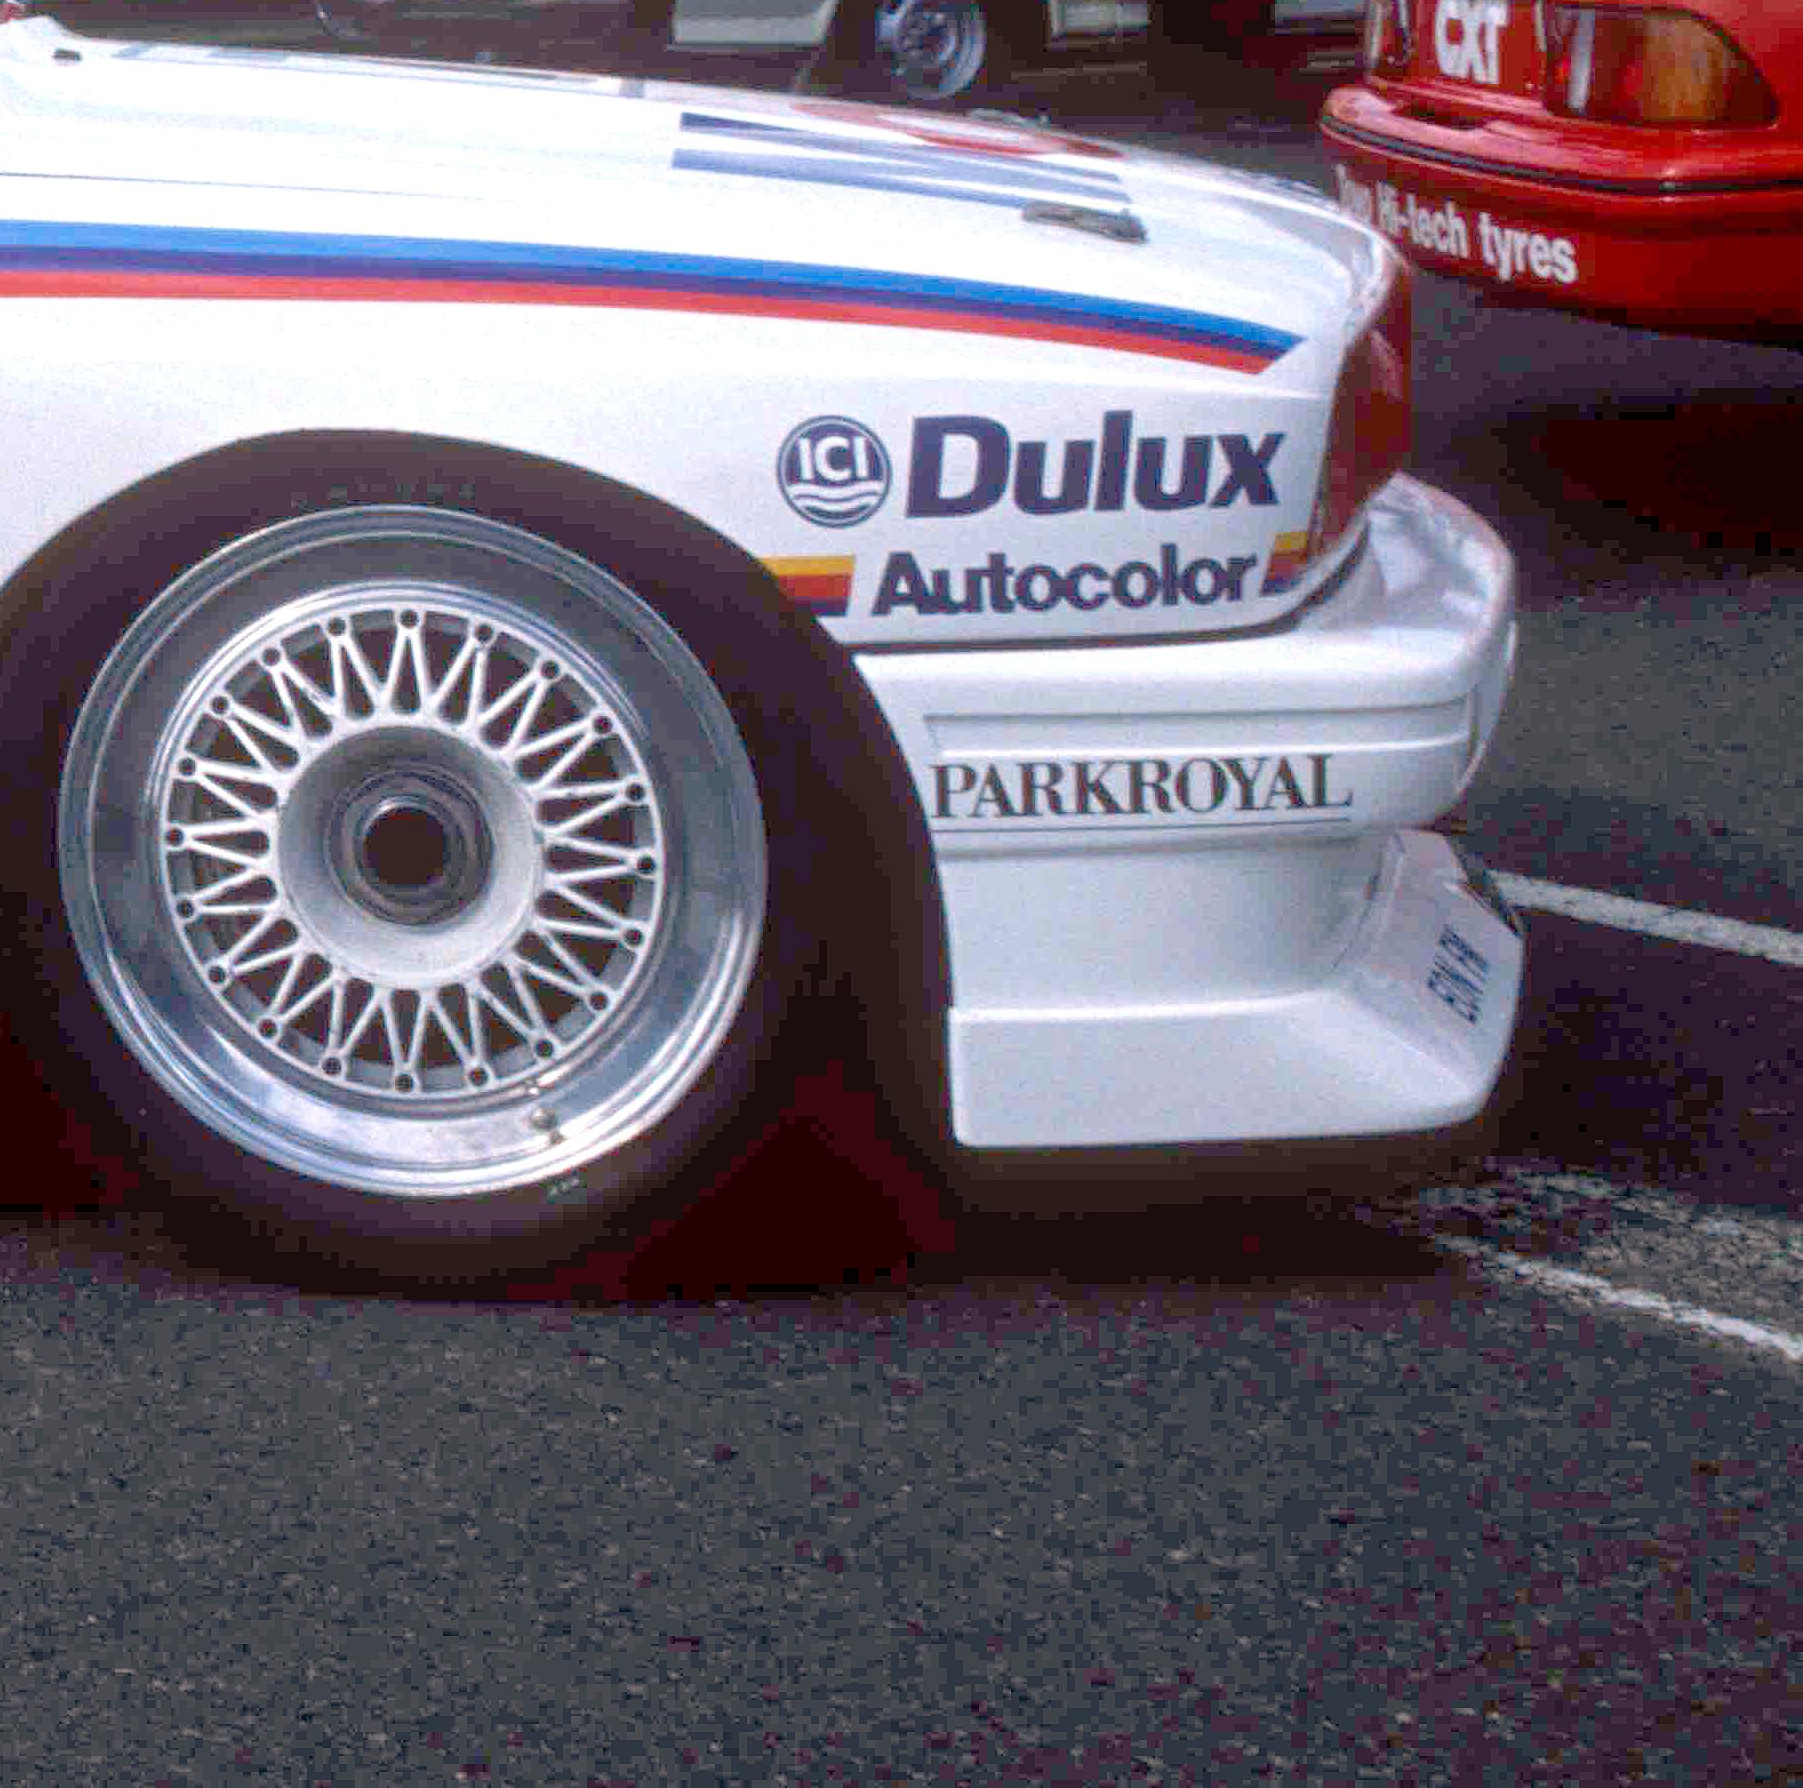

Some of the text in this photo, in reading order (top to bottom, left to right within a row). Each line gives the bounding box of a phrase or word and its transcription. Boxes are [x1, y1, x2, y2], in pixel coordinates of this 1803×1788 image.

[1478, 211, 1580, 285] tyres
[796, 434, 870, 482] ICI
[906, 409, 1287, 518] Dulux
[870, 542, 1257, 616] Autocolor
[931, 753, 1354, 819] PARKROYAL
